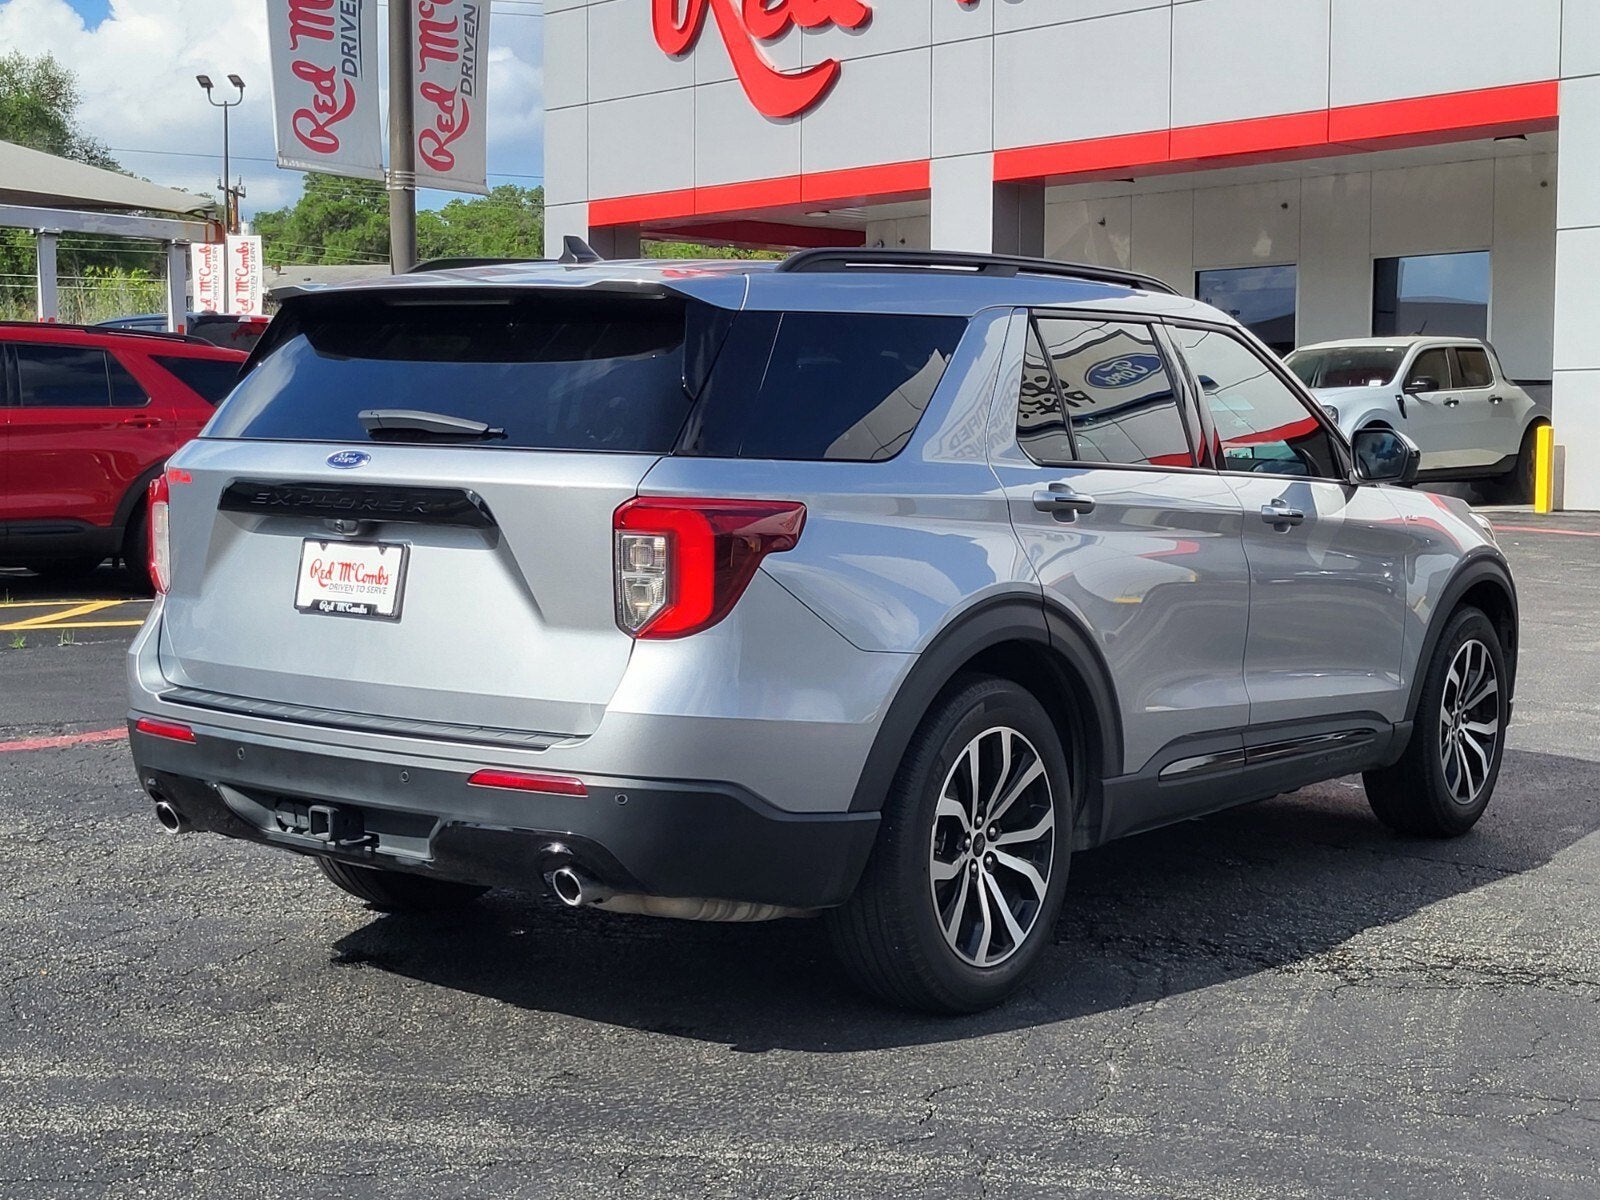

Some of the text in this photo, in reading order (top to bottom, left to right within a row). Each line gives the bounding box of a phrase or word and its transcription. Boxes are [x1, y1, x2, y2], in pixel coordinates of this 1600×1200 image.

[340, 0, 358, 78] DRIVE
[460, 3, 477, 97] DRIVEN
[292, 60, 356, 154] Red
[418, 82, 470, 172] Red
[199, 245, 217, 311] ed McComb
[212, 264, 218, 274] TO
[235, 241, 249, 297] McCombs
[250, 265, 256, 274] TO
[250, 492, 430, 514] EXPLORER
[310, 558, 390, 588] Red McCombs
[328, 582, 388, 595] DRIVEN TO SERVE
[319, 600, 368, 614] Red McCombs
